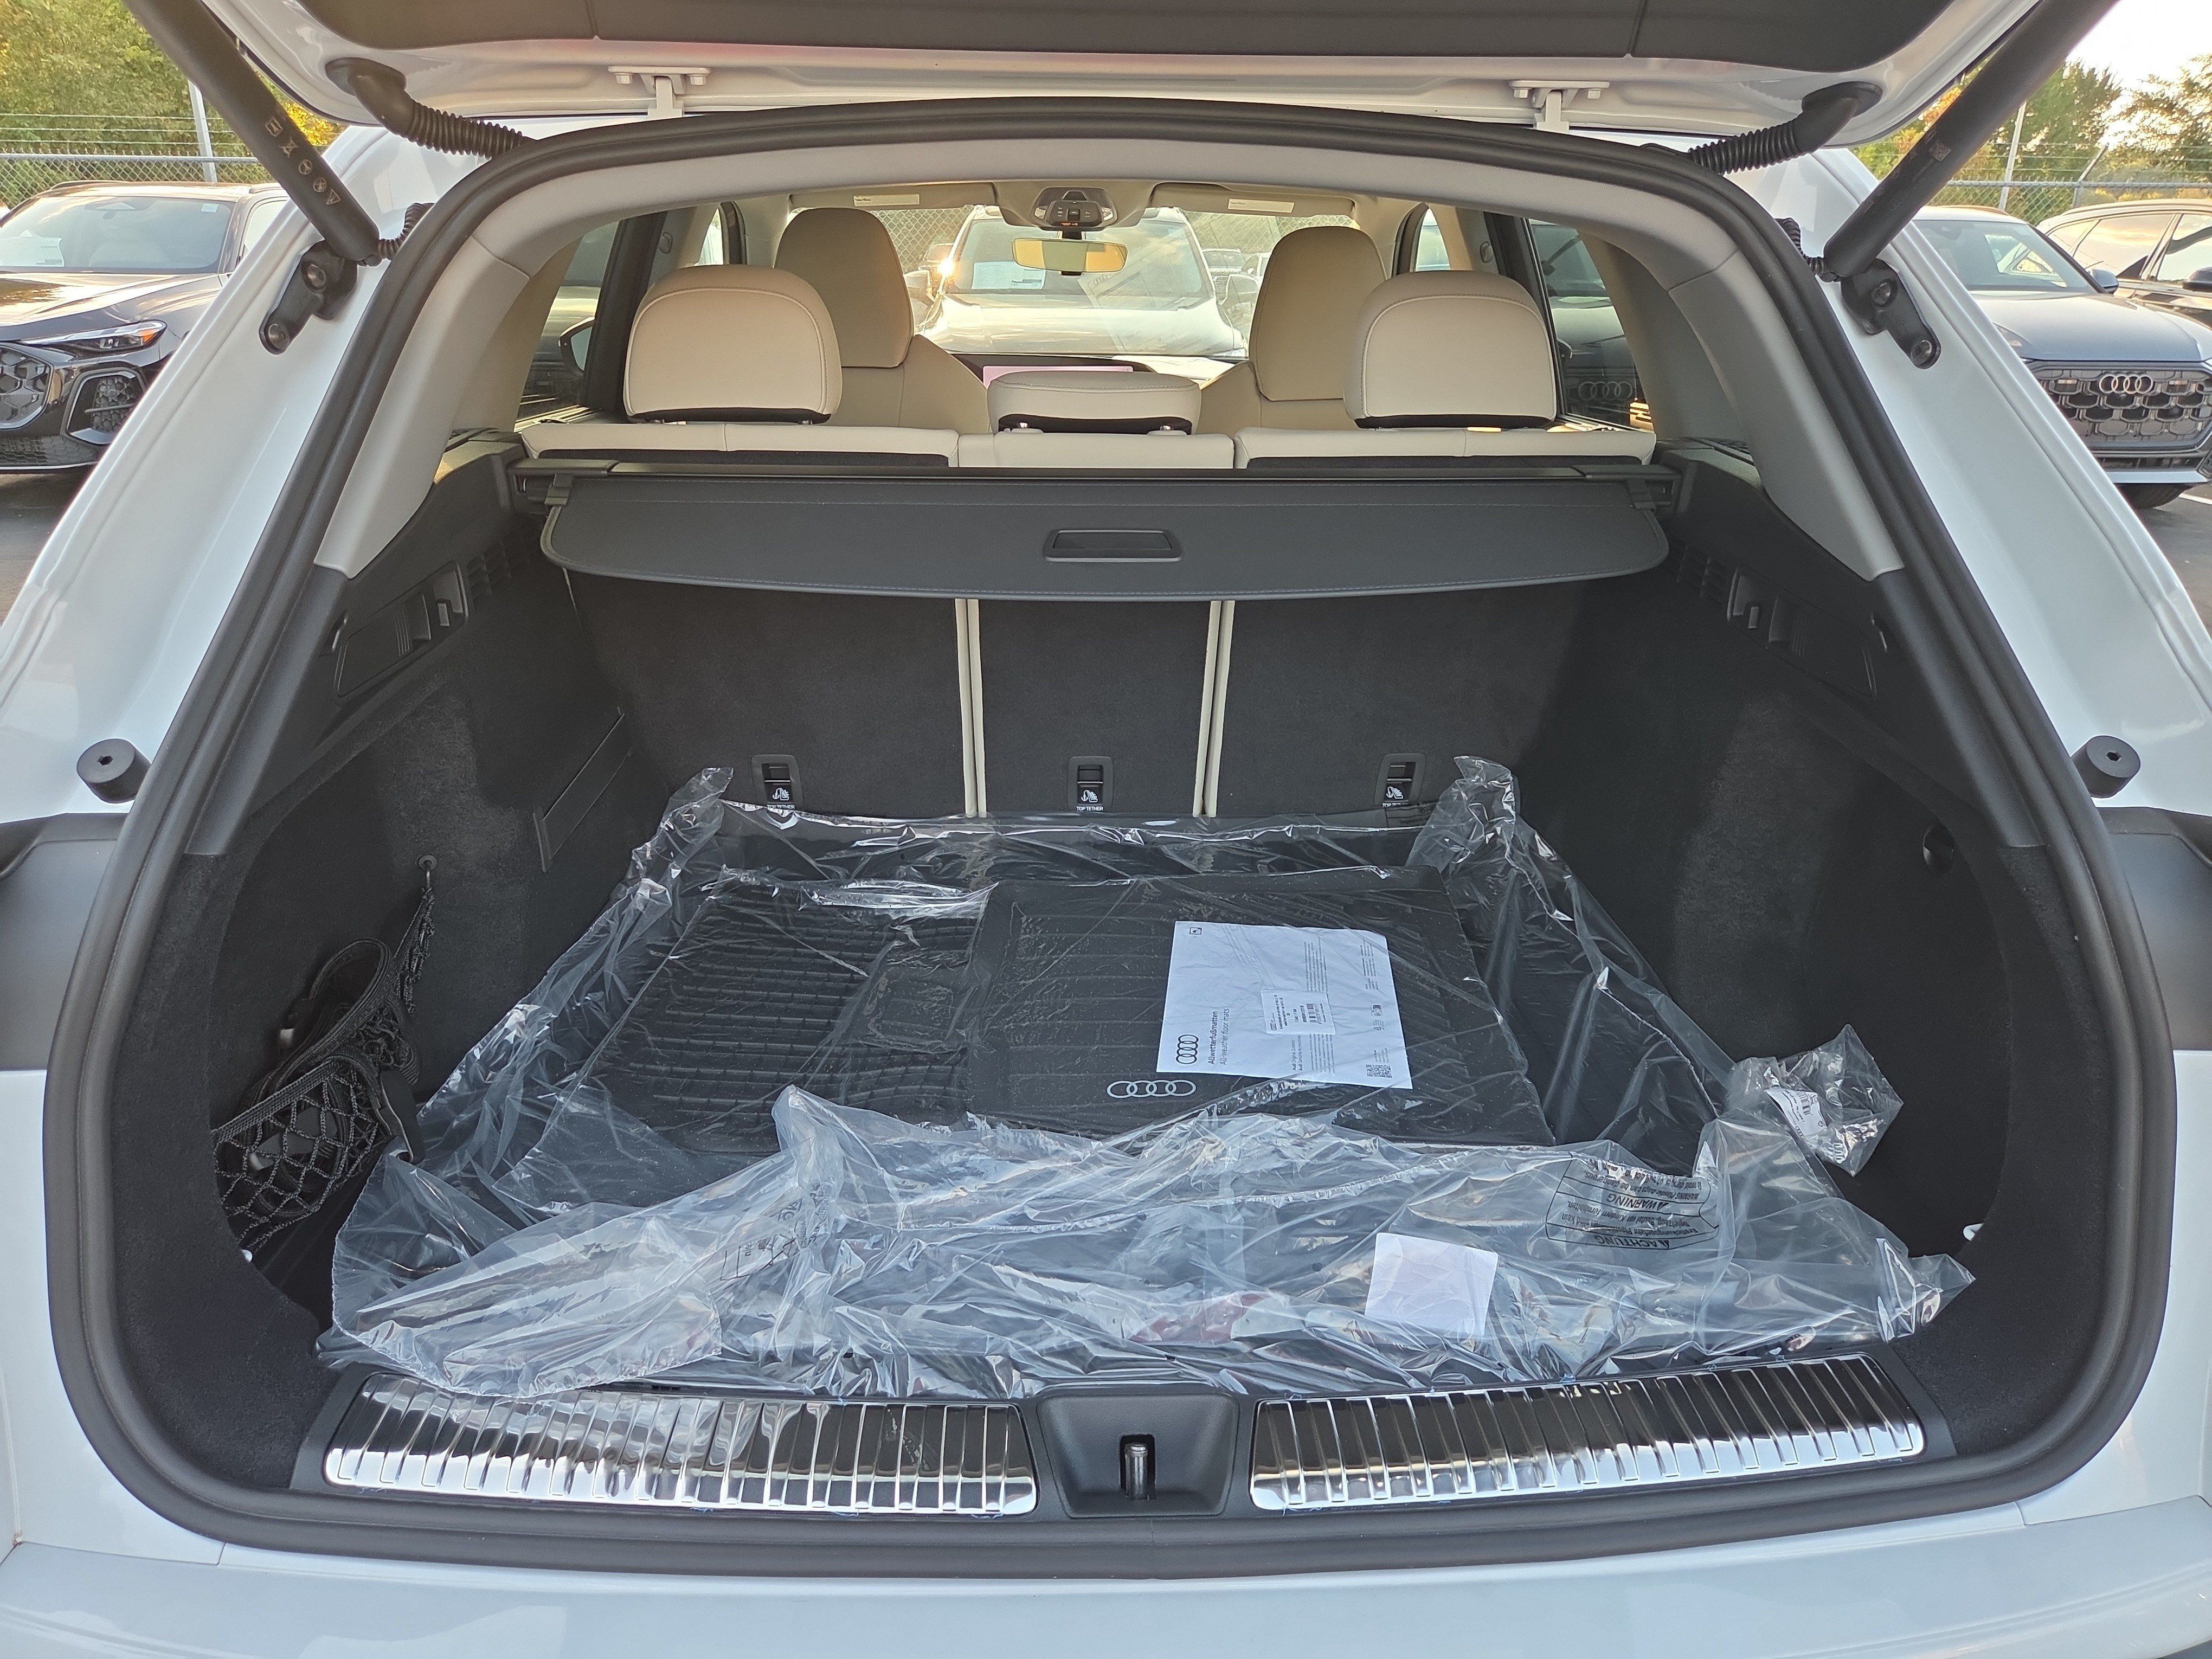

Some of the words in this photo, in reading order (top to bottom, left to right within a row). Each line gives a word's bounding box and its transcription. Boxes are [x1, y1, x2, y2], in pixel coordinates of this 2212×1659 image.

[1221, 1022, 1229, 1034] floor
[1207, 1011, 1218, 1065] Allwetterfußmatten
[1219, 1035, 1229, 1065] All-weather
[1606, 1193, 1658, 1211] WARNING
[1561, 1213, 1575, 1225] kein
[1577, 1217, 1589, 1227] sind
[1594, 1235, 1657, 1248] ACHTUNG
